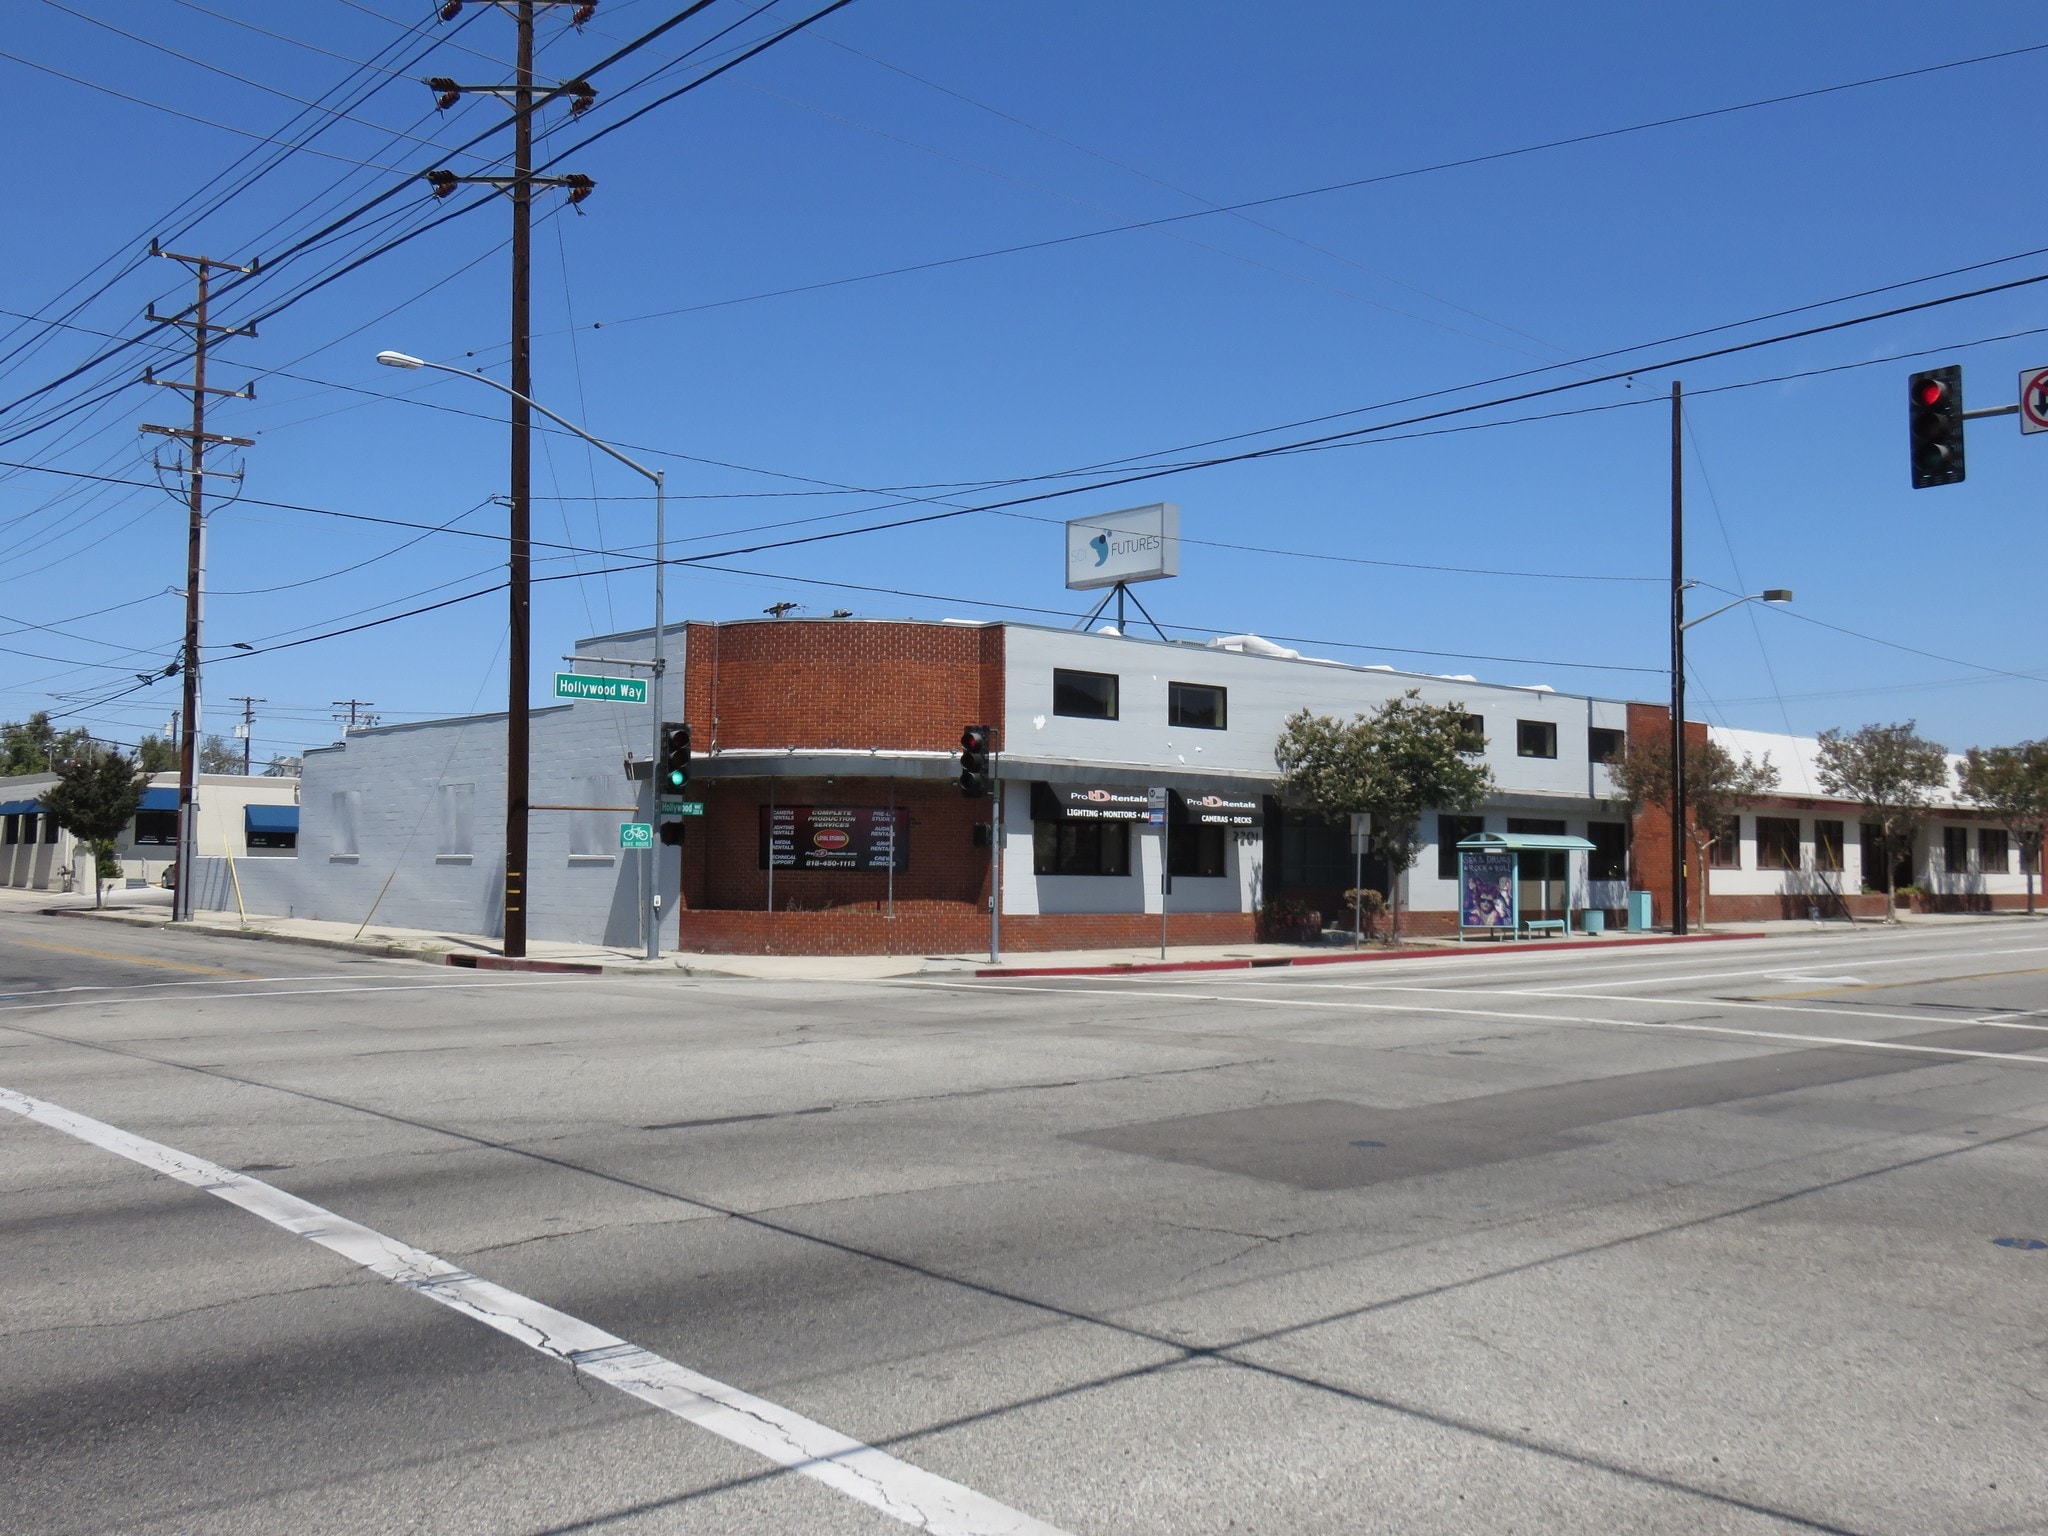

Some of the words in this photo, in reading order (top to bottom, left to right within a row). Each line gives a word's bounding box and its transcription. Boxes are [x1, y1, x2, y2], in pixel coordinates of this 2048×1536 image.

[1111, 535, 1160, 556] FUTURES
[560, 679, 616, 696] Hollywood
[620, 684, 643, 700] Way
[662, 802, 693, 813] Hollywood
[1066, 808, 1099, 818] LIGHTING
[1103, 810, 1137, 819] MONITORS
[1141, 811, 1150, 819] AU
[1201, 814, 1229, 823] CAMERAS
[1233, 816, 1252, 824] DECKS
[1233, 831, 1259, 843] 2201
[1486, 855, 1512, 864] DRUGS
[1495, 864, 1512, 872] ROLL
